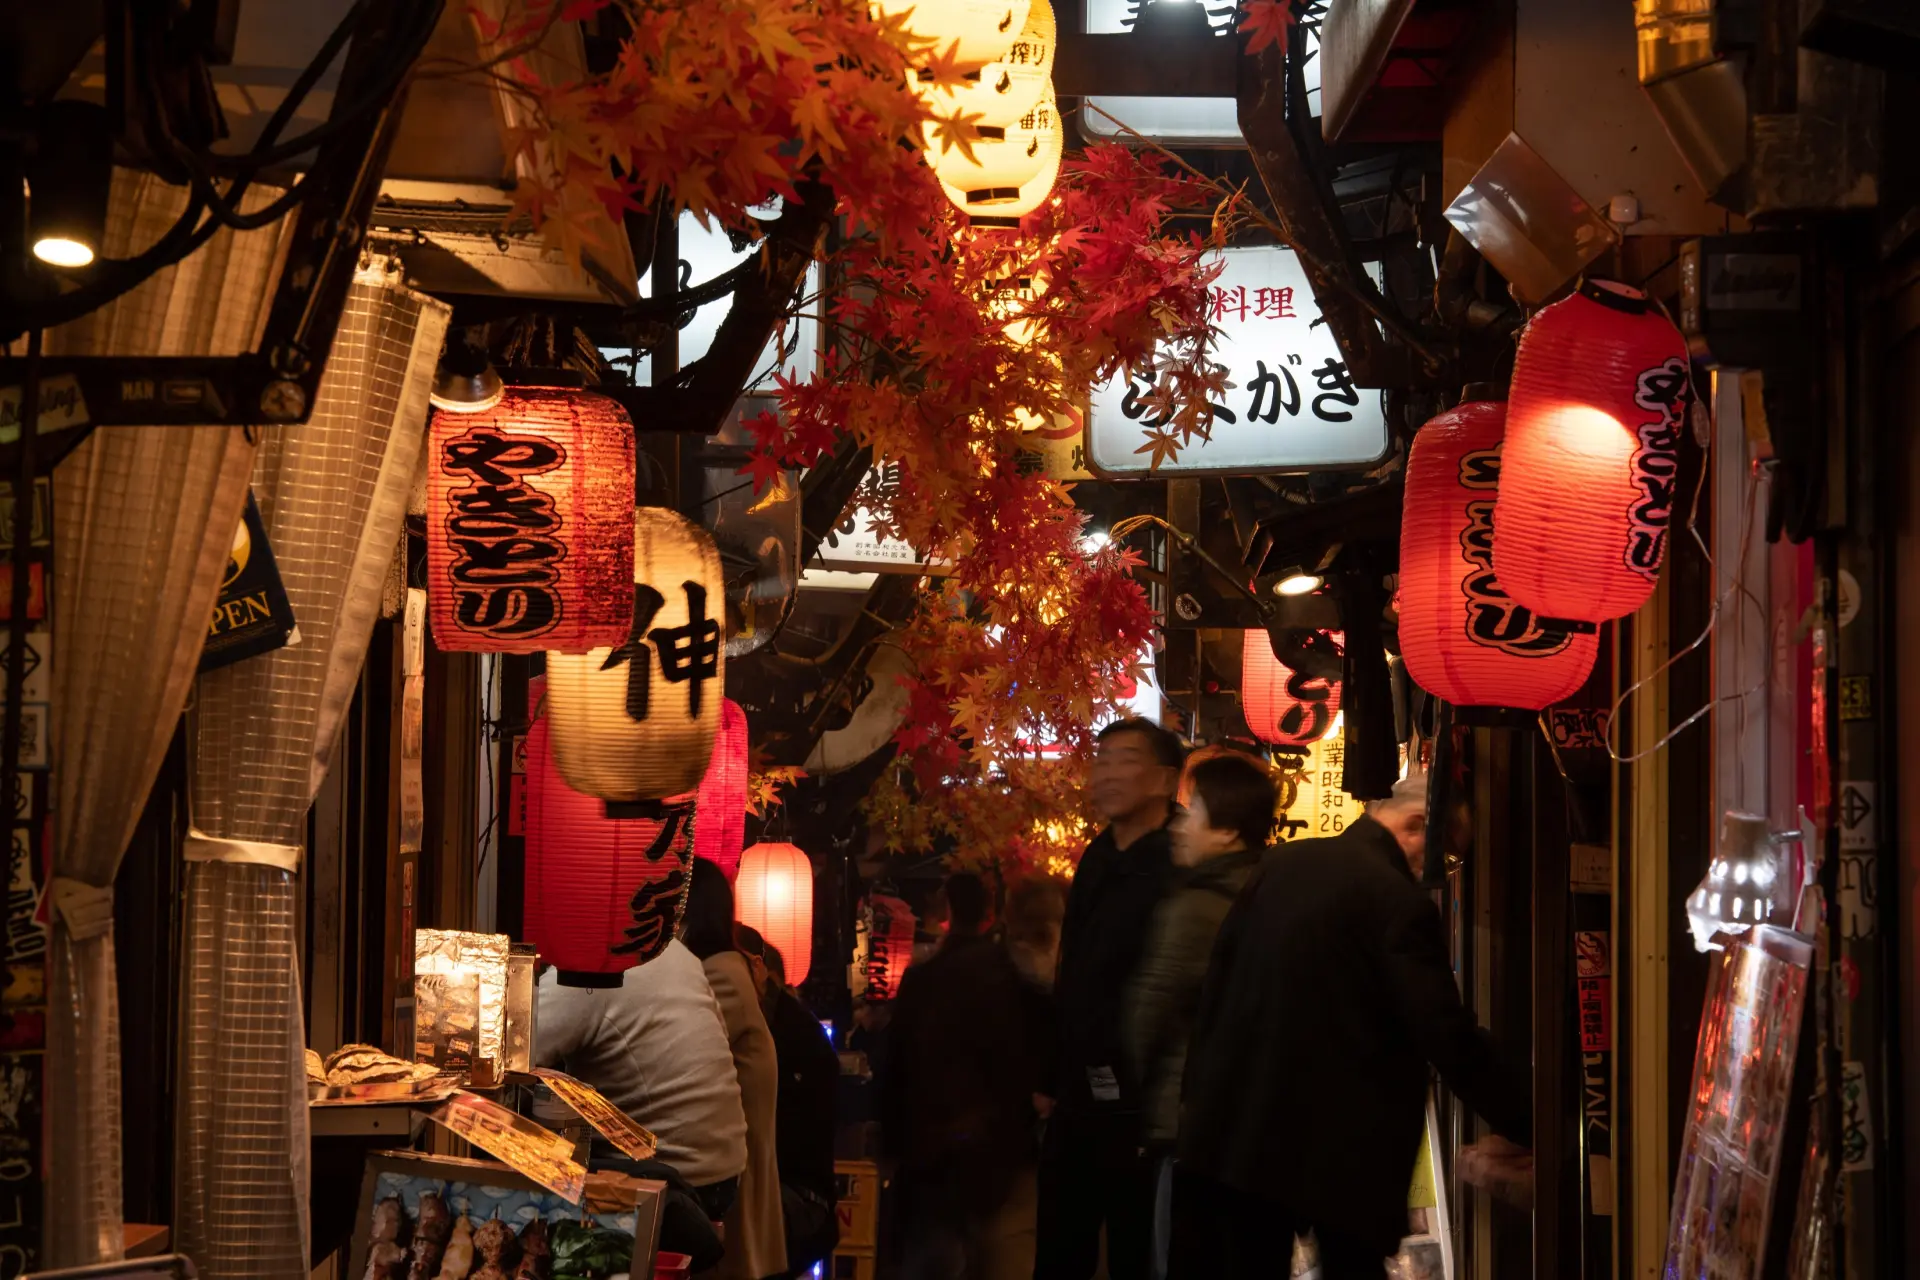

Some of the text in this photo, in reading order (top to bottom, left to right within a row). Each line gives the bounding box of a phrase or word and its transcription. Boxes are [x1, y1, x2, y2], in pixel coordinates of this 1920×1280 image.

[1000, 42, 1045, 66] 搾り
[1207, 285, 1298, 322] 料理
[444, 430, 565, 633] やきとり
[209, 591, 271, 636] PEN
[601, 580, 720, 722] 神
[1320, 728, 1345, 832] 業昭和26
